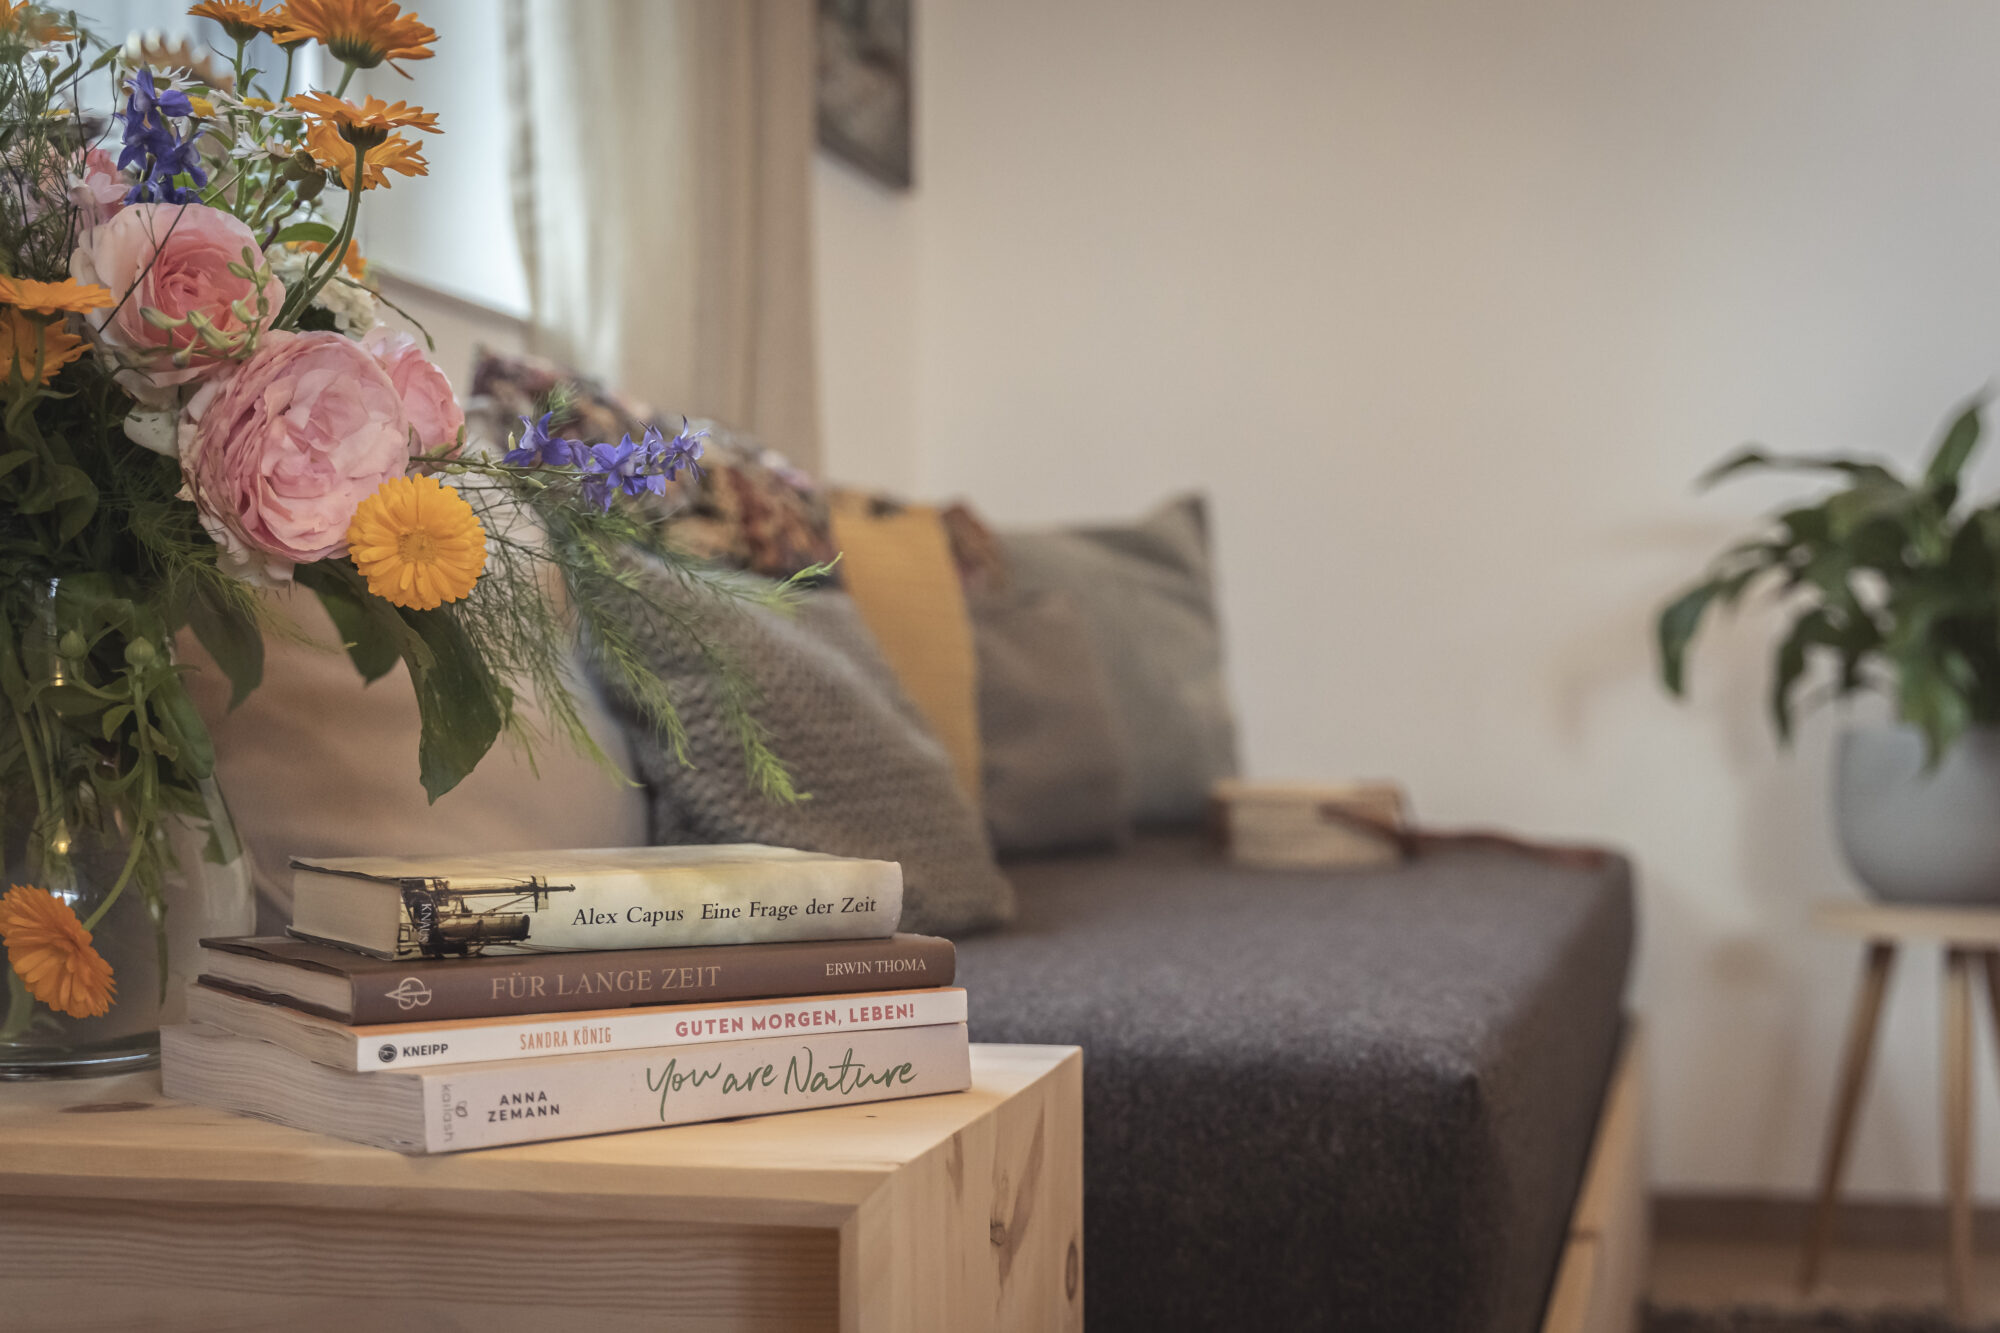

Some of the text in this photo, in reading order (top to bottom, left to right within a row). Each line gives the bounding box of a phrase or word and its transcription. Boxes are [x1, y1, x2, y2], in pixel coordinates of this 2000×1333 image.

[571, 906, 684, 927] Alex Capus
[700, 896, 877, 921] Eine Frage der Zeit
[419, 902, 432, 944] KNAUS
[825, 958, 926, 976] ERWIN THOMA
[491, 966, 721, 1000] FÜR LANGE ZEIT
[675, 1003, 915, 1037] GUTEN MORGEN, LEBEN!
[402, 1043, 449, 1058] KNEIPP
[519, 1027, 612, 1050] SANDRA KÖNIG
[646, 1046, 918, 1122] You are Nature
[499, 1091, 548, 1106] ANNA
[441, 1083, 455, 1143] kailash
[488, 1104, 560, 1122] ZEMANN
